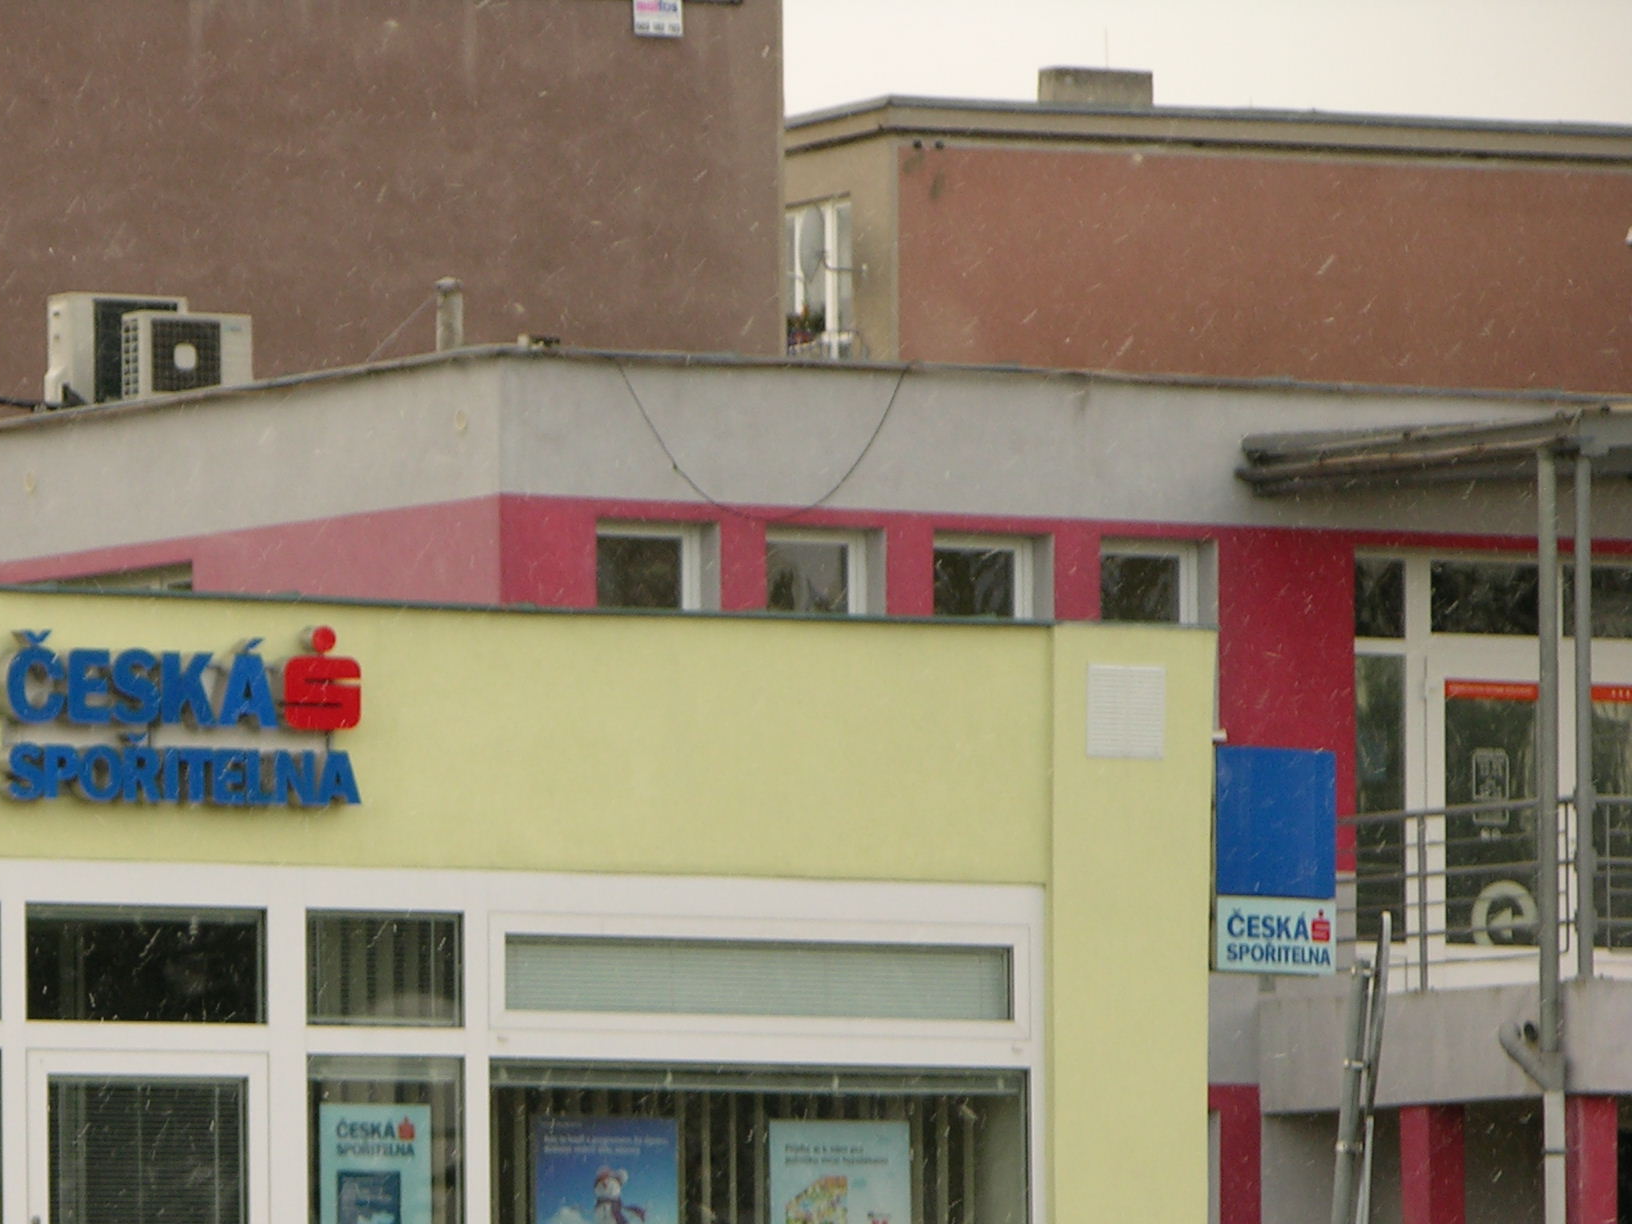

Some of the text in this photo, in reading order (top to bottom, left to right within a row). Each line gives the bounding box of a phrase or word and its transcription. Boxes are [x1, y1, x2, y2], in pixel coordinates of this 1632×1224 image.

[7, 629, 279, 729] ČESKÁ
[9, 733, 362, 805] SPOŘITELNA
[1227, 907, 1309, 941] ČESKÁ
[1227, 942, 1331, 966] SPOŘITELNA
[336, 1117, 396, 1139] ČESKÁ
